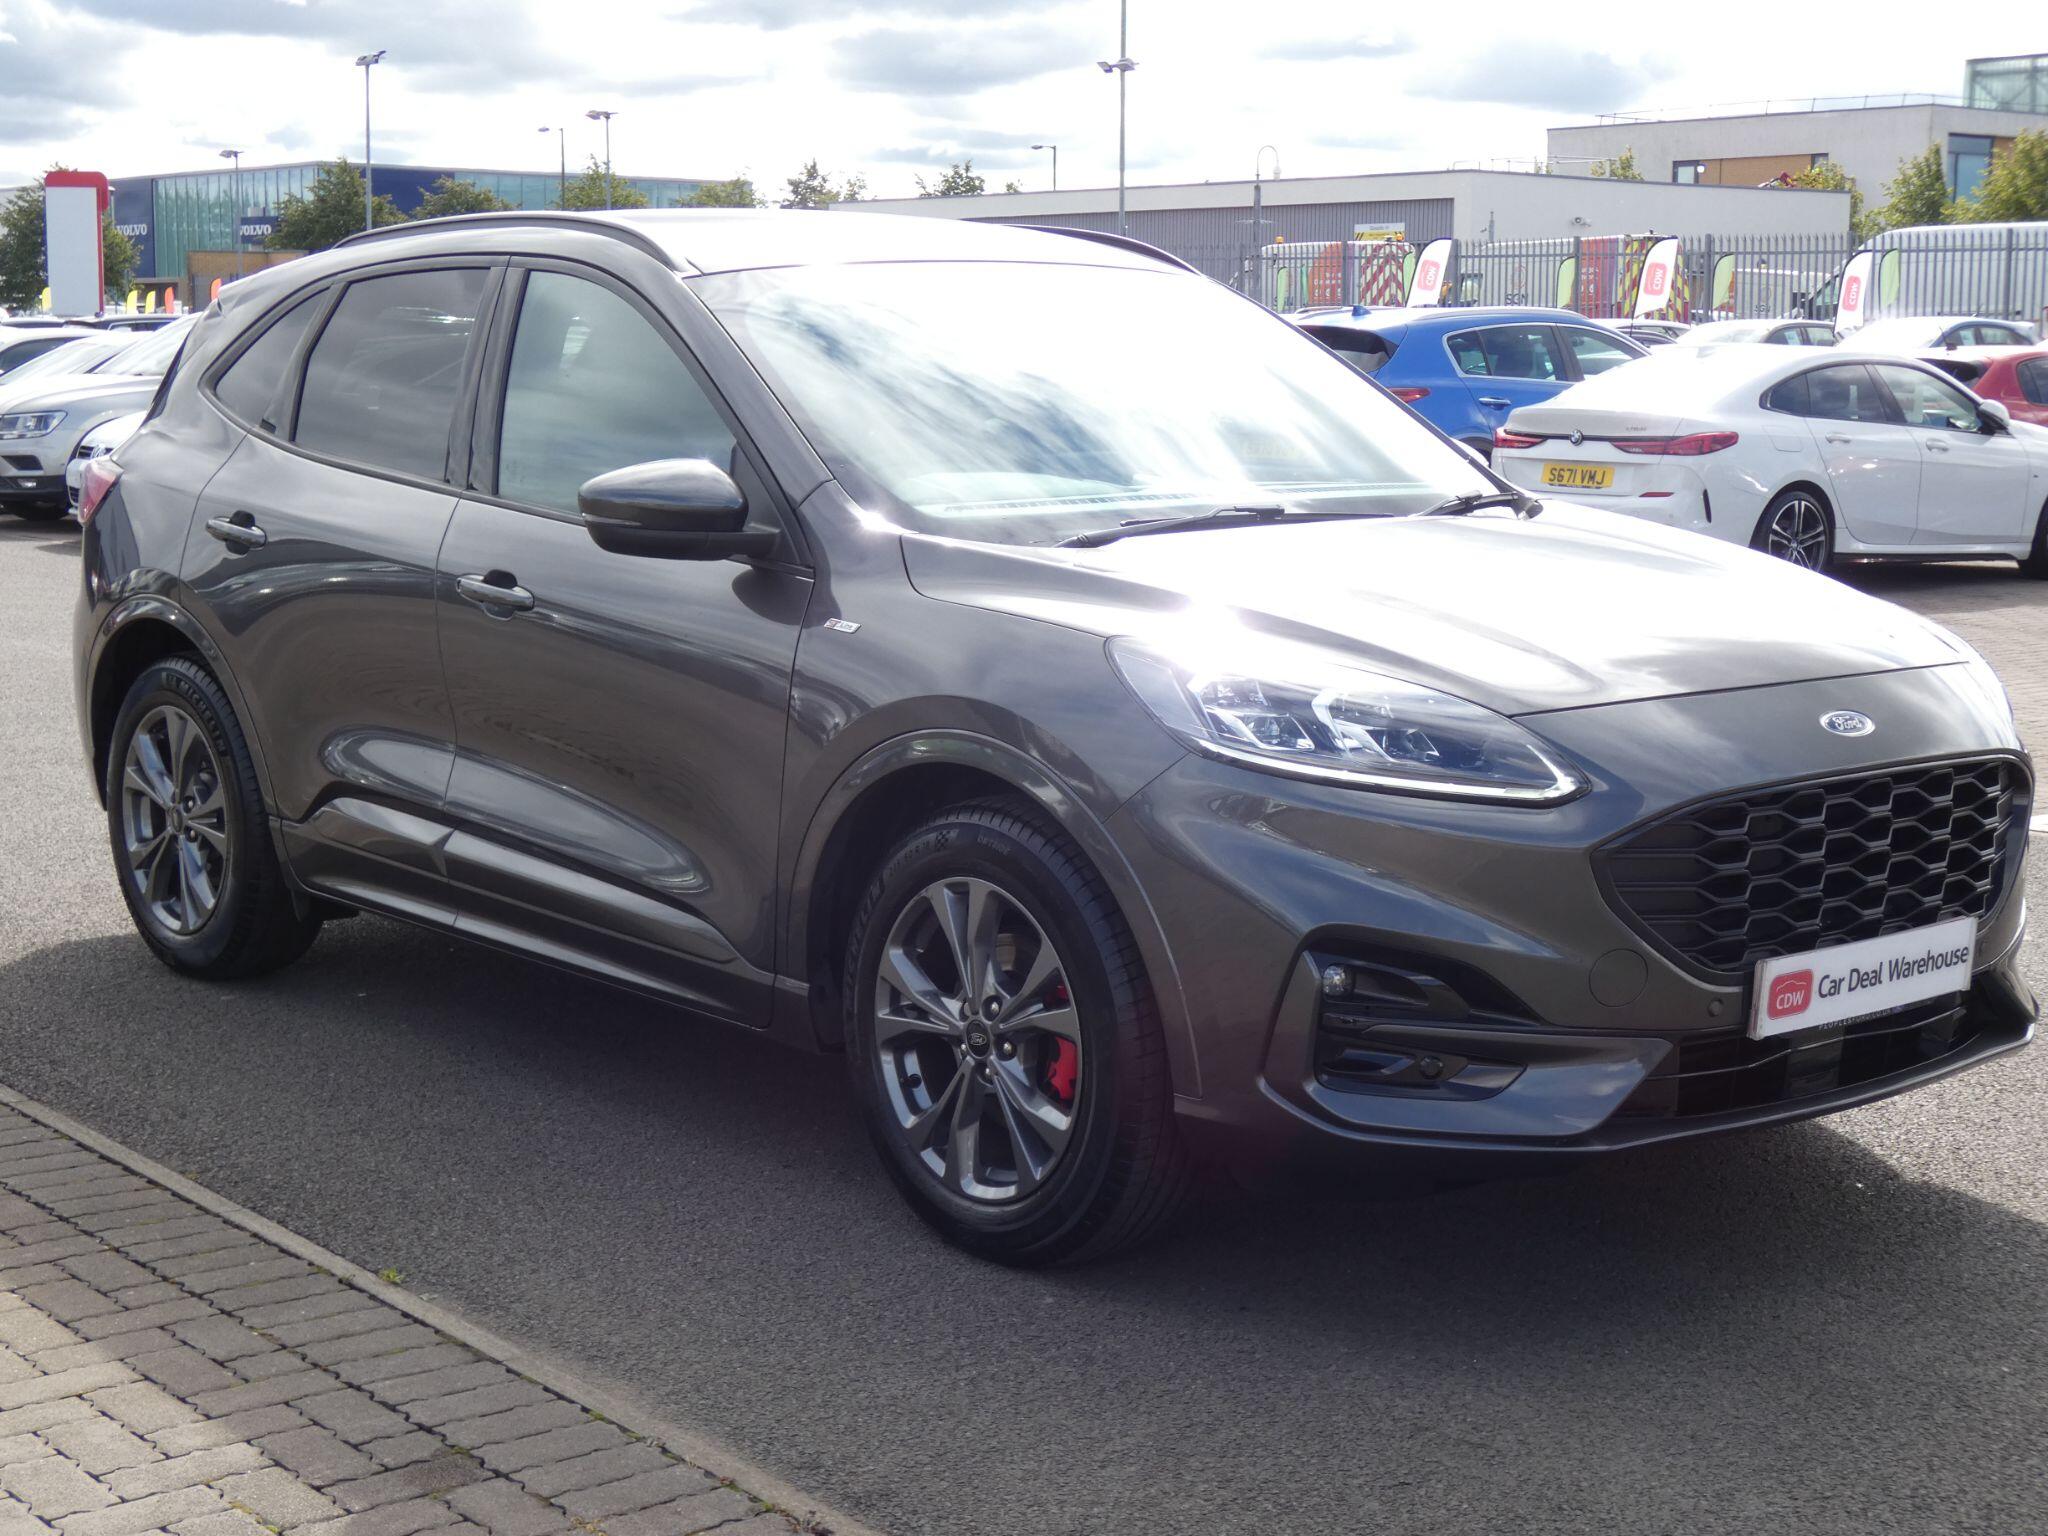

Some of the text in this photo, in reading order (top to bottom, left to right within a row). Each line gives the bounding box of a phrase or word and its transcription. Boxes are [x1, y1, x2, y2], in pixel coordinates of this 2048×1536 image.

[116, 223, 148, 237] VOLVO
[1425, 266, 1438, 286] CDW
[1652, 268, 1665, 290] CDW
[1848, 282, 1859, 305] CDW
[1581, 469, 1606, 485] VMJ
[178, 680, 227, 753] MICHELIN
[1832, 715, 1862, 731] Ford
[1818, 945, 1970, 999] Car Deal Warehouse
[1776, 989, 1805, 1011] CDW
